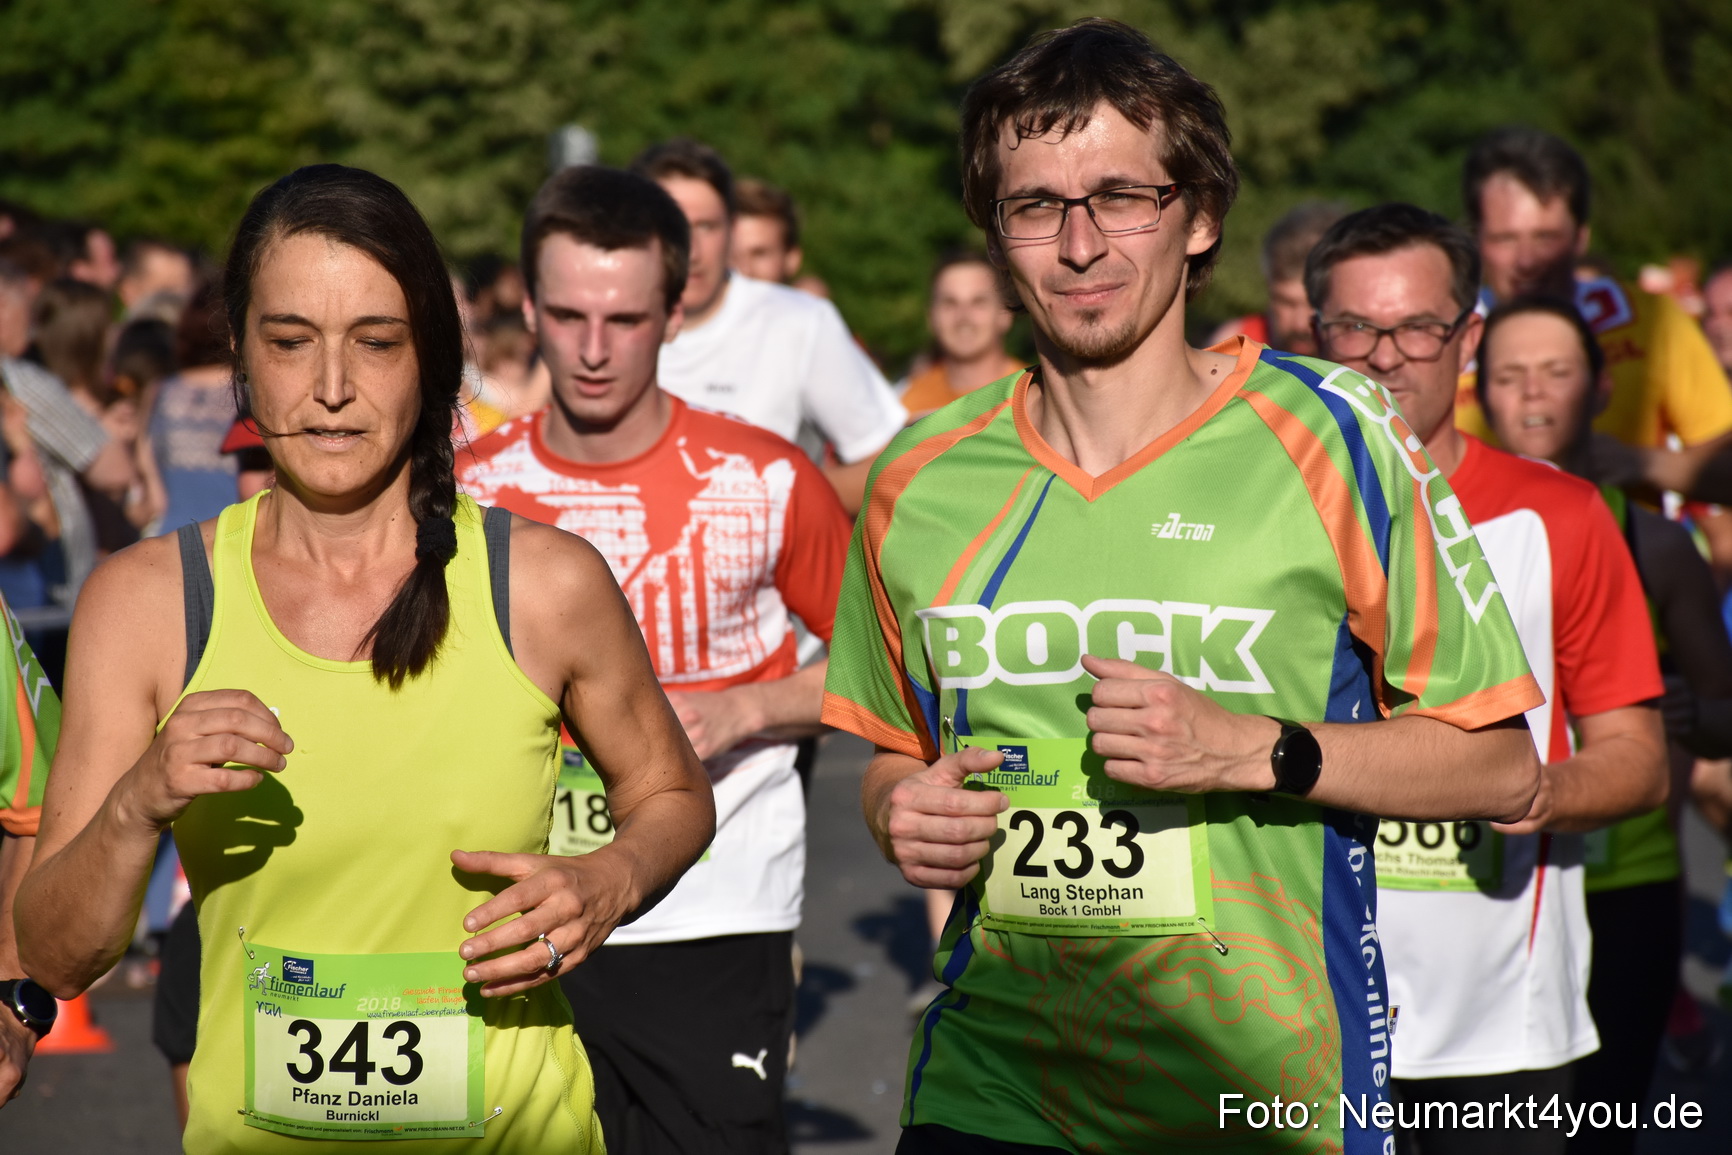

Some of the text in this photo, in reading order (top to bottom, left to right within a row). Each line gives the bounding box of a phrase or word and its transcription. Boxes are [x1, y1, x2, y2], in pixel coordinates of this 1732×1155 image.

[916, 600, 1274, 693] BOCK
[987, 770, 1060, 787] firmenlauf
[1009, 810, 1145, 879] 233
[1020, 882, 1144, 904] Lang Stephan
[1039, 904, 1122, 916] Bock 1 GmbH
[270, 977, 347, 998] firmenlauf
[356, 997, 402, 1011] 2018
[286, 1019, 424, 1086] 343
[292, 1087, 418, 1106] Pfanz Daniela
[326, 1110, 380, 1122] Burnickl
